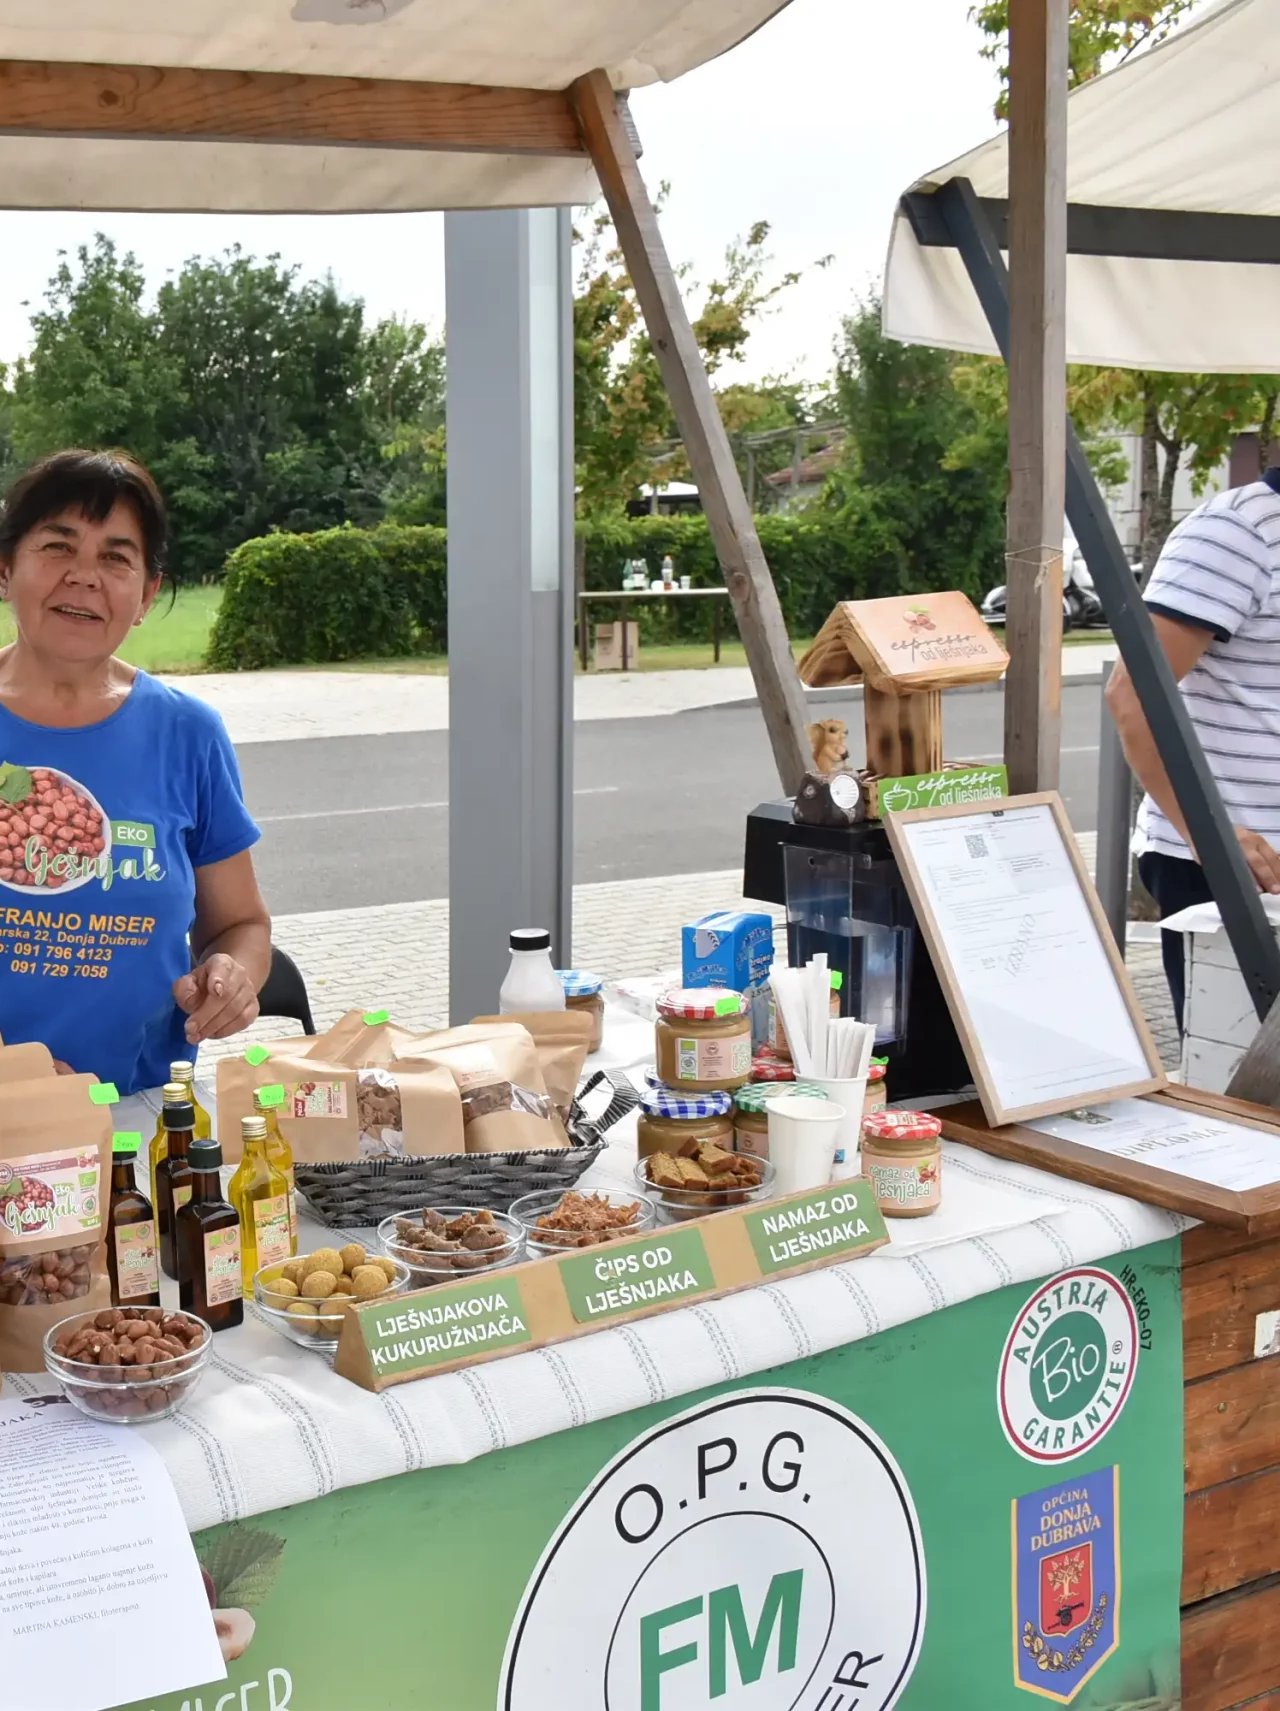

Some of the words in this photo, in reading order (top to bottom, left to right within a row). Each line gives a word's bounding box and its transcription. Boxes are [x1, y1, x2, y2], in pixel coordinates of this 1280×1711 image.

[921, 648, 936, 661] od
[939, 789, 953, 806] od
[117, 826, 148, 842] EKO
[24, 835, 166, 891] lješnjak
[34, 930, 52, 943] 22,
[57, 931, 96, 946] Donja
[89, 914, 156, 934] MISER
[14, 942, 40, 957] 091
[46, 945, 73, 960] 796
[76, 947, 112, 961] 4123
[10, 959, 36, 974] 091
[42, 962, 69, 977] 729
[74, 964, 109, 979] 7058
[1114, 1127, 1228, 1157] DIPLOMA
[904, 1166, 916, 1179] od
[55, 1186, 70, 1194] EKO
[876, 1180, 930, 1204] ješnjaka
[762, 1200, 831, 1236] NAMAZ
[831, 1193, 859, 1216] OD
[769, 1218, 871, 1263] LJEŠNJAKA
[595, 1254, 640, 1283] ČIPS
[642, 1246, 672, 1270] OD
[585, 1270, 699, 1315] LJEŠNJAKA
[376, 1293, 509, 1338] LJEŠNJAKOVA
[1120, 1263, 1152, 1351] HR-EKO-07
[1013, 1280, 1108, 1365] AUSTRIA
[371, 1315, 526, 1367] KUKURUŽNJAČA
[1033, 1336, 1100, 1403] Bio
[1022, 1359, 1127, 1450] GARANTIE
[1042, 1487, 1089, 1514] OPĆINA
[1039, 1505, 1092, 1532] DONJA
[1030, 1517, 1102, 1552] DUBRAVA
[8, 1575, 25, 1585] kože
[13, 1621, 52, 1636] MARTINA
[640, 1568, 804, 1711] FM
